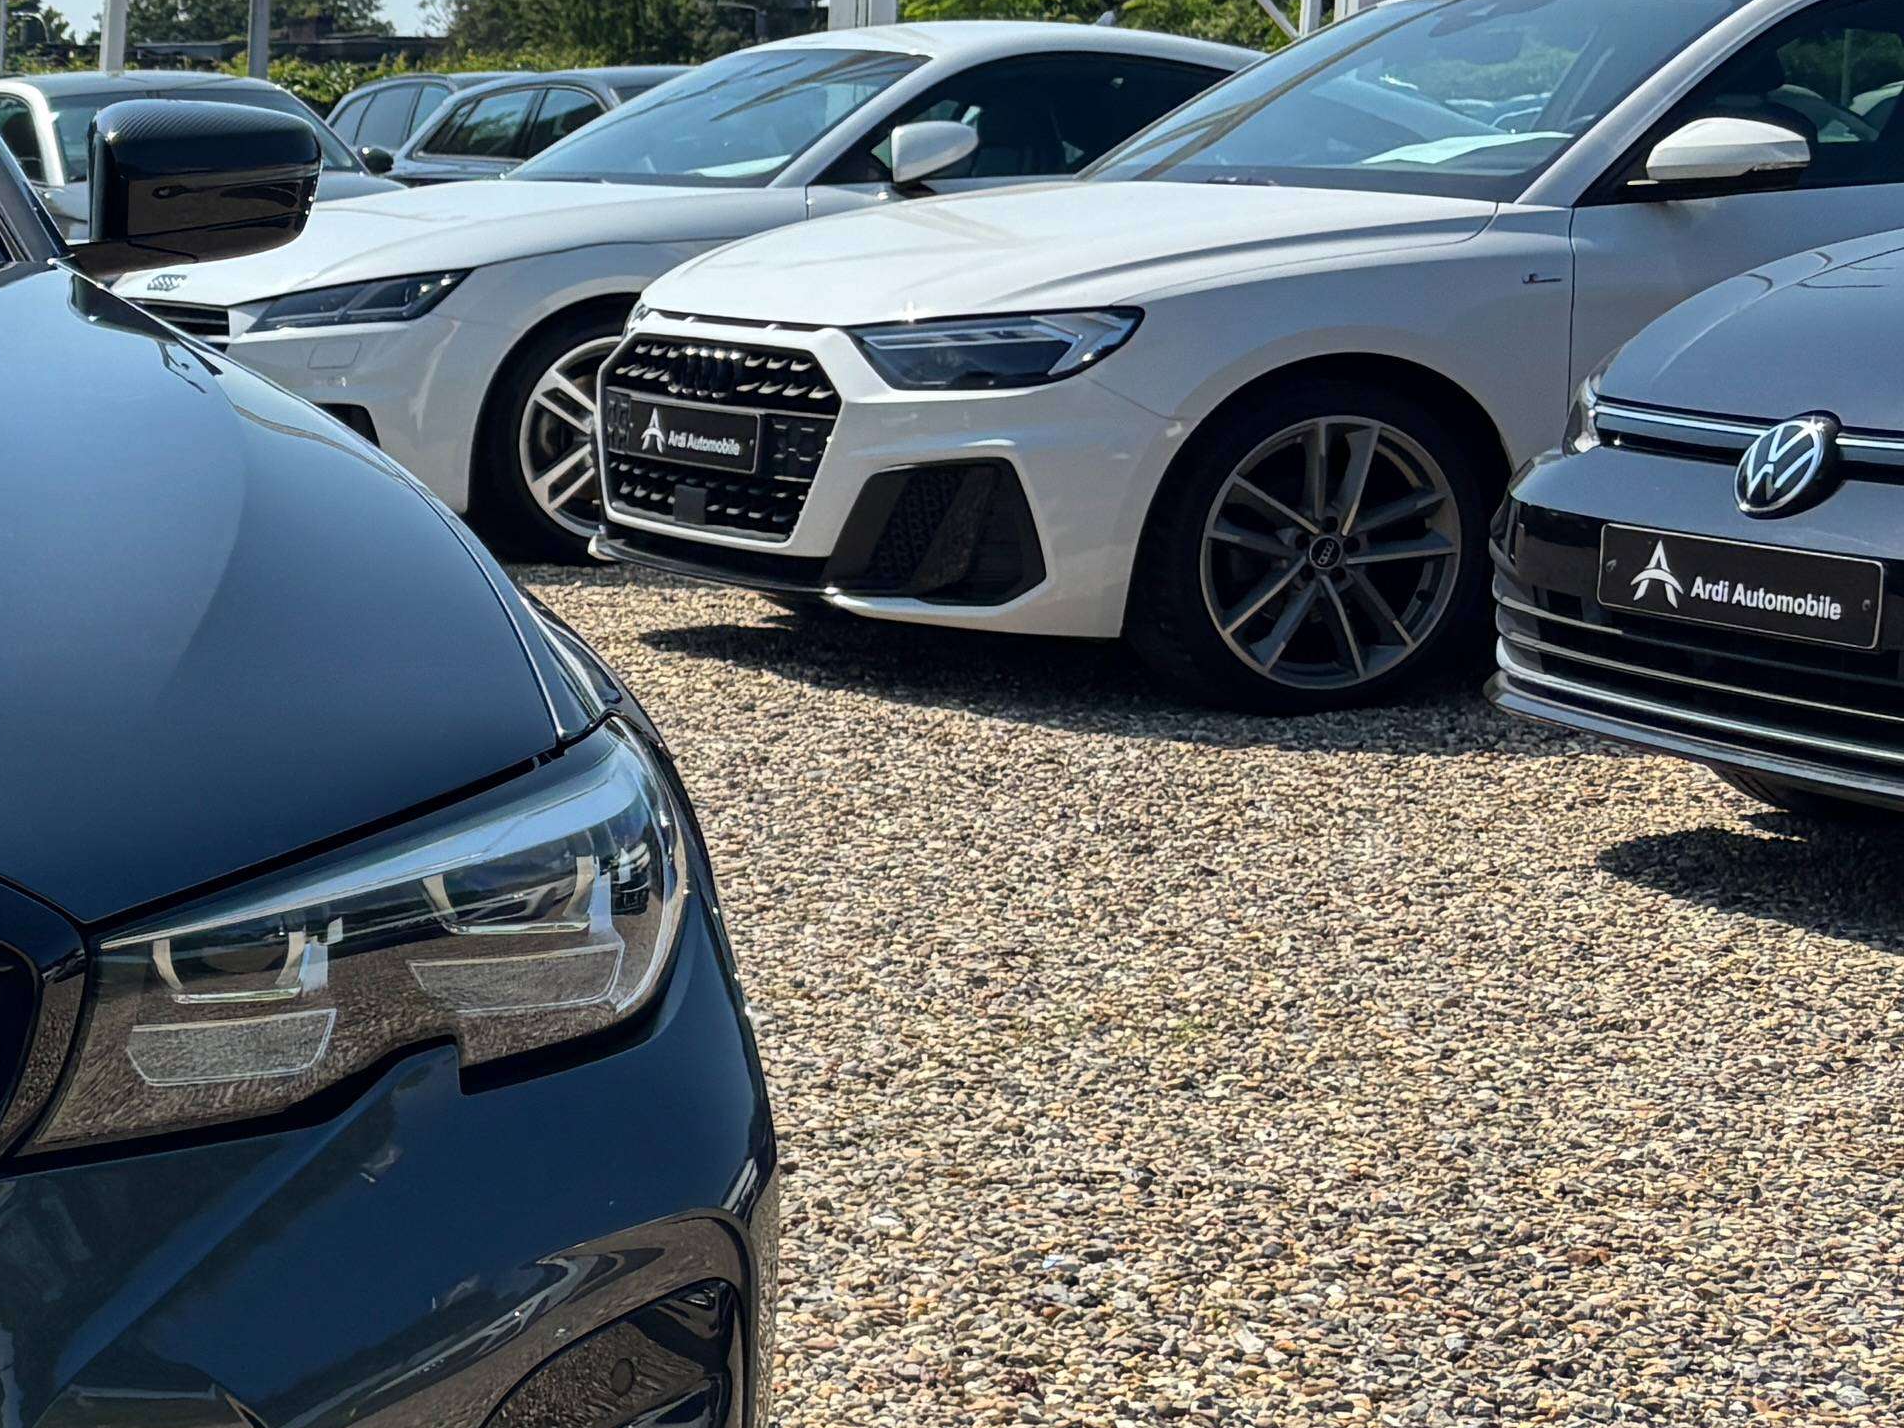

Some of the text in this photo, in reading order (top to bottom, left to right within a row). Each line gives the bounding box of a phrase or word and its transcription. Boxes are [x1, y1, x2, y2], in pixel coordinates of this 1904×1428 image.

[667, 430, 741, 457] Ardi Automobile
[1691, 576, 1842, 621] Ardi Automobile
